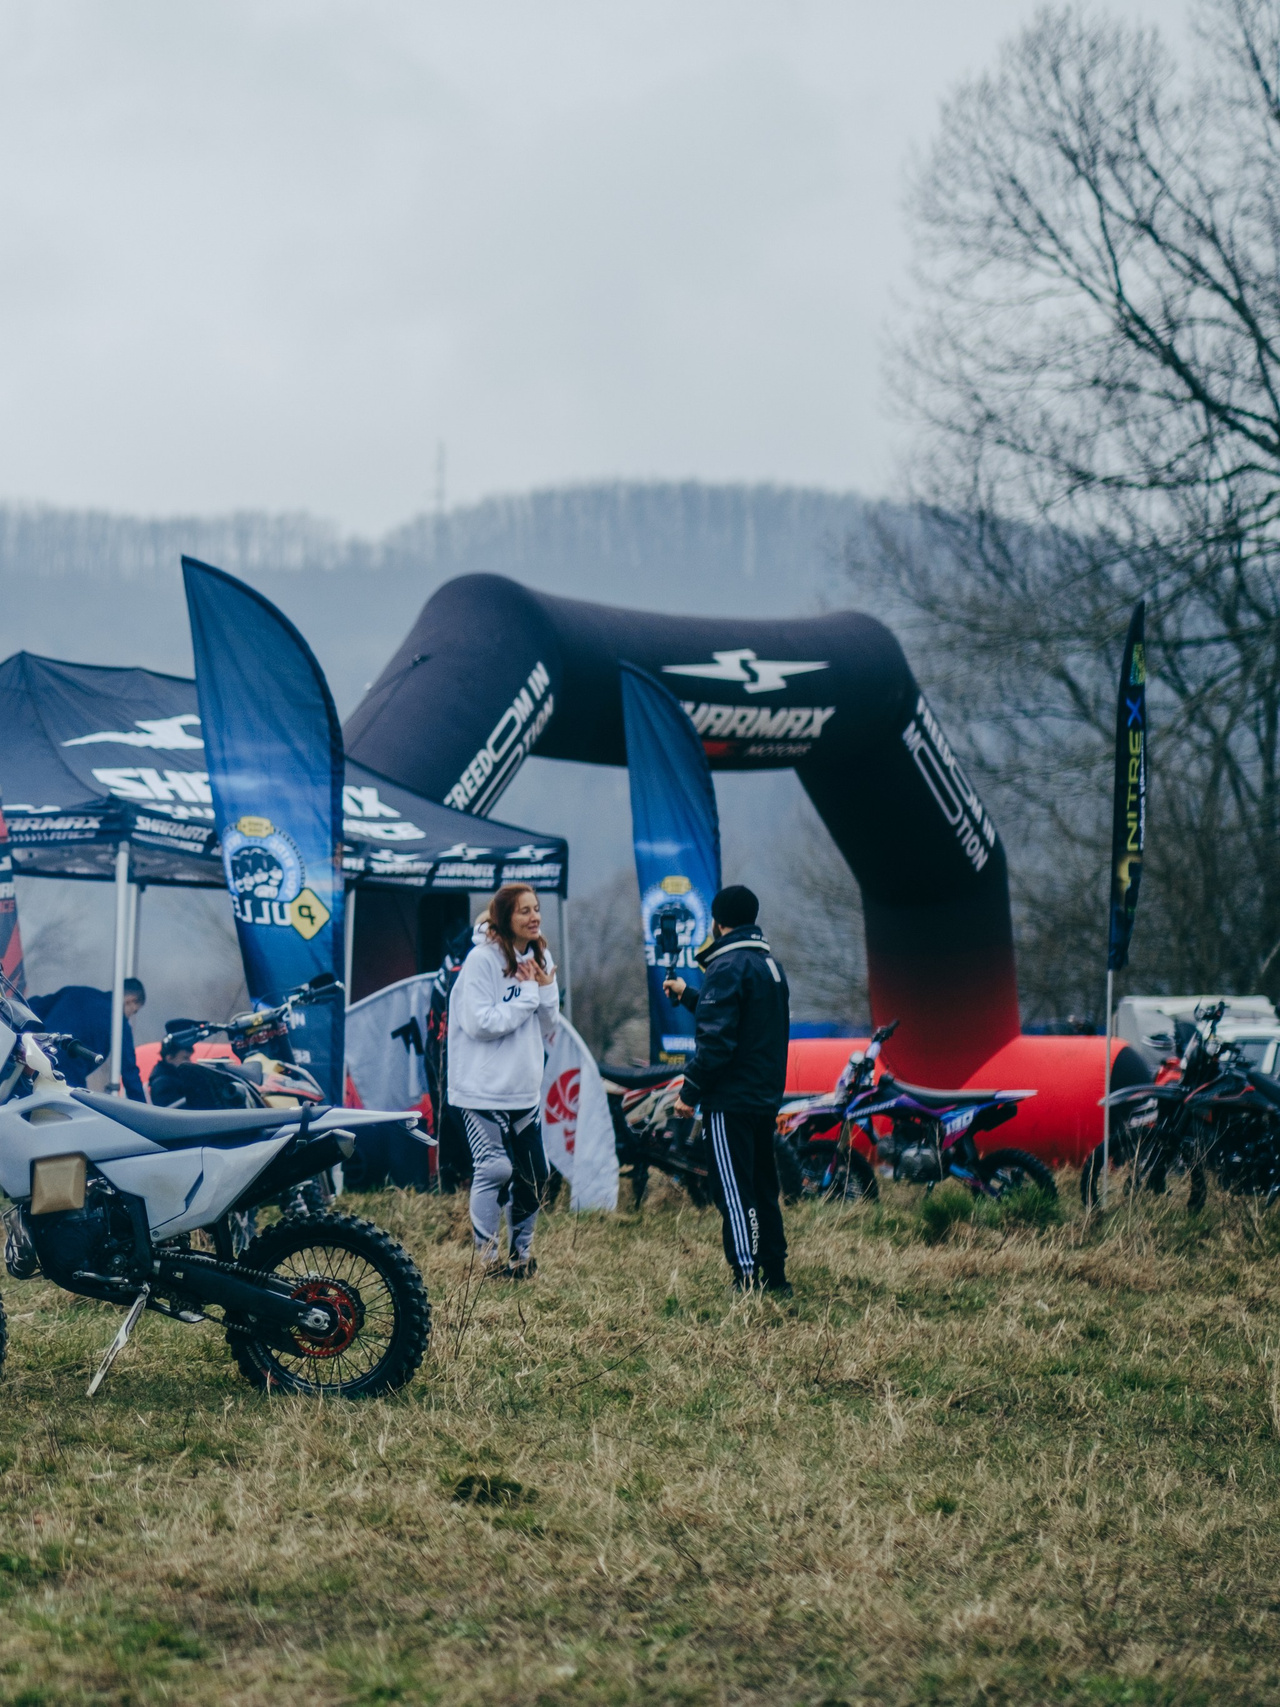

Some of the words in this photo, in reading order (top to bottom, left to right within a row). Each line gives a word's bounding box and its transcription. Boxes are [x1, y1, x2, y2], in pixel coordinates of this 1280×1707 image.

[527, 660, 550, 701] IN
[679, 700, 837, 739] HARMAX
[916, 695, 983, 824] FREEDOM
[902, 719, 989, 872] MOTION
[3, 815, 104, 832] ARMAX
[748, 1207, 760, 1256] adidas
